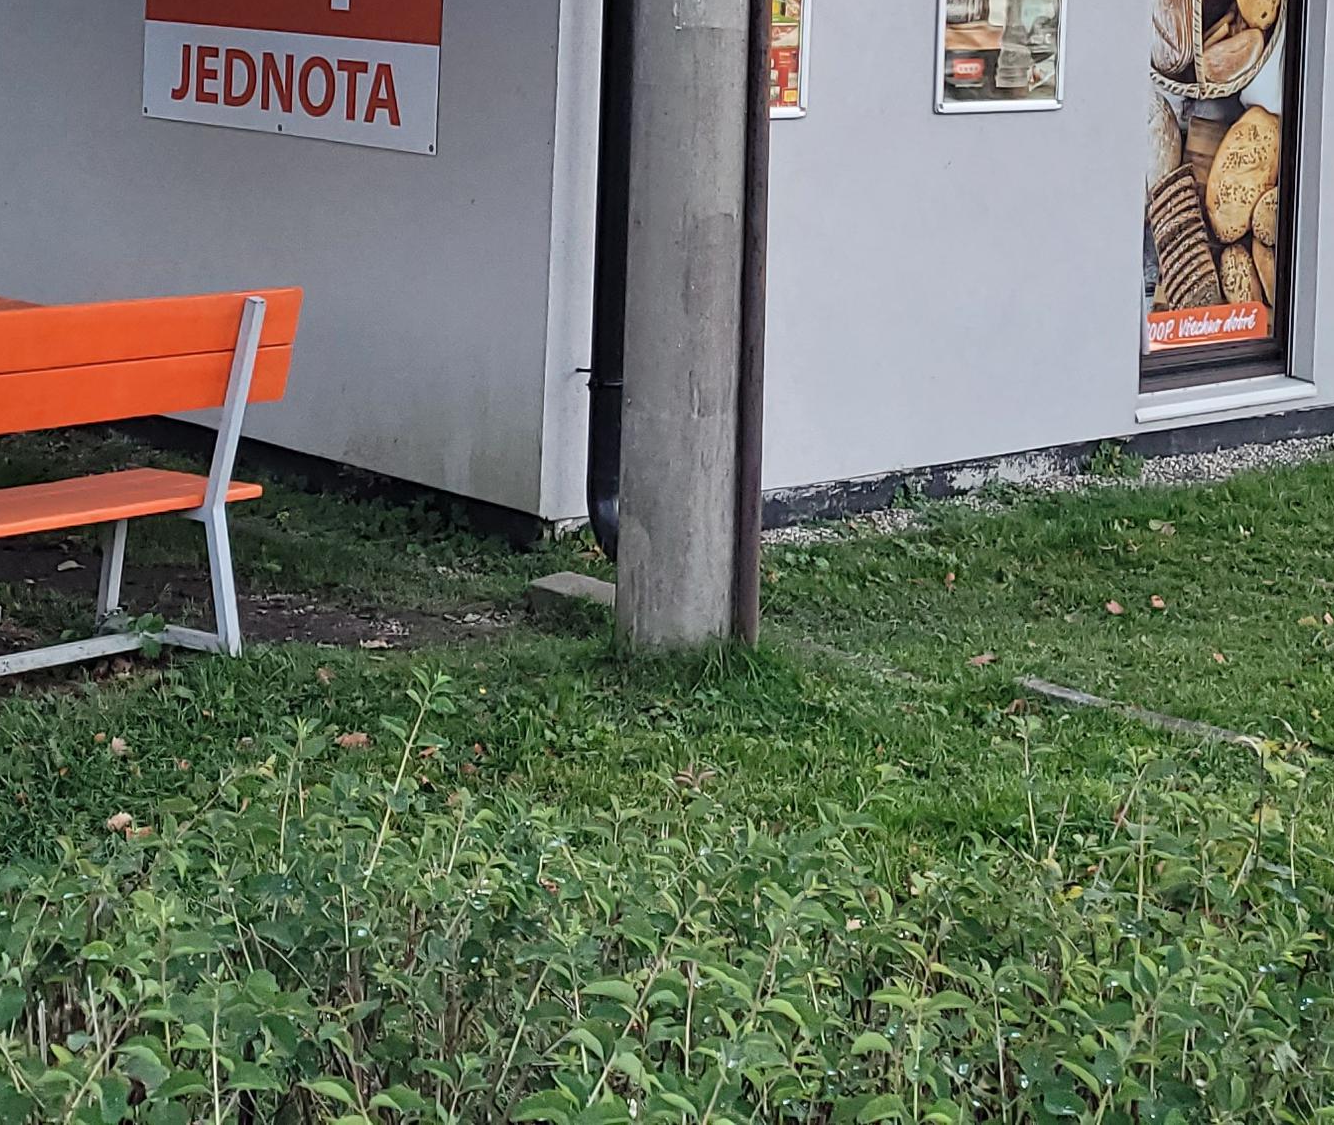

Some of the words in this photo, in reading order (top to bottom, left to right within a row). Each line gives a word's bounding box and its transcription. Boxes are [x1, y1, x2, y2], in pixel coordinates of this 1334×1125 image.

[170, 43, 401, 127] JEDNOTA
[1148, 319, 1175, 341] OOP.
[1178, 312, 1223, 338] Všechno
[1223, 308, 1258, 332] dobré
